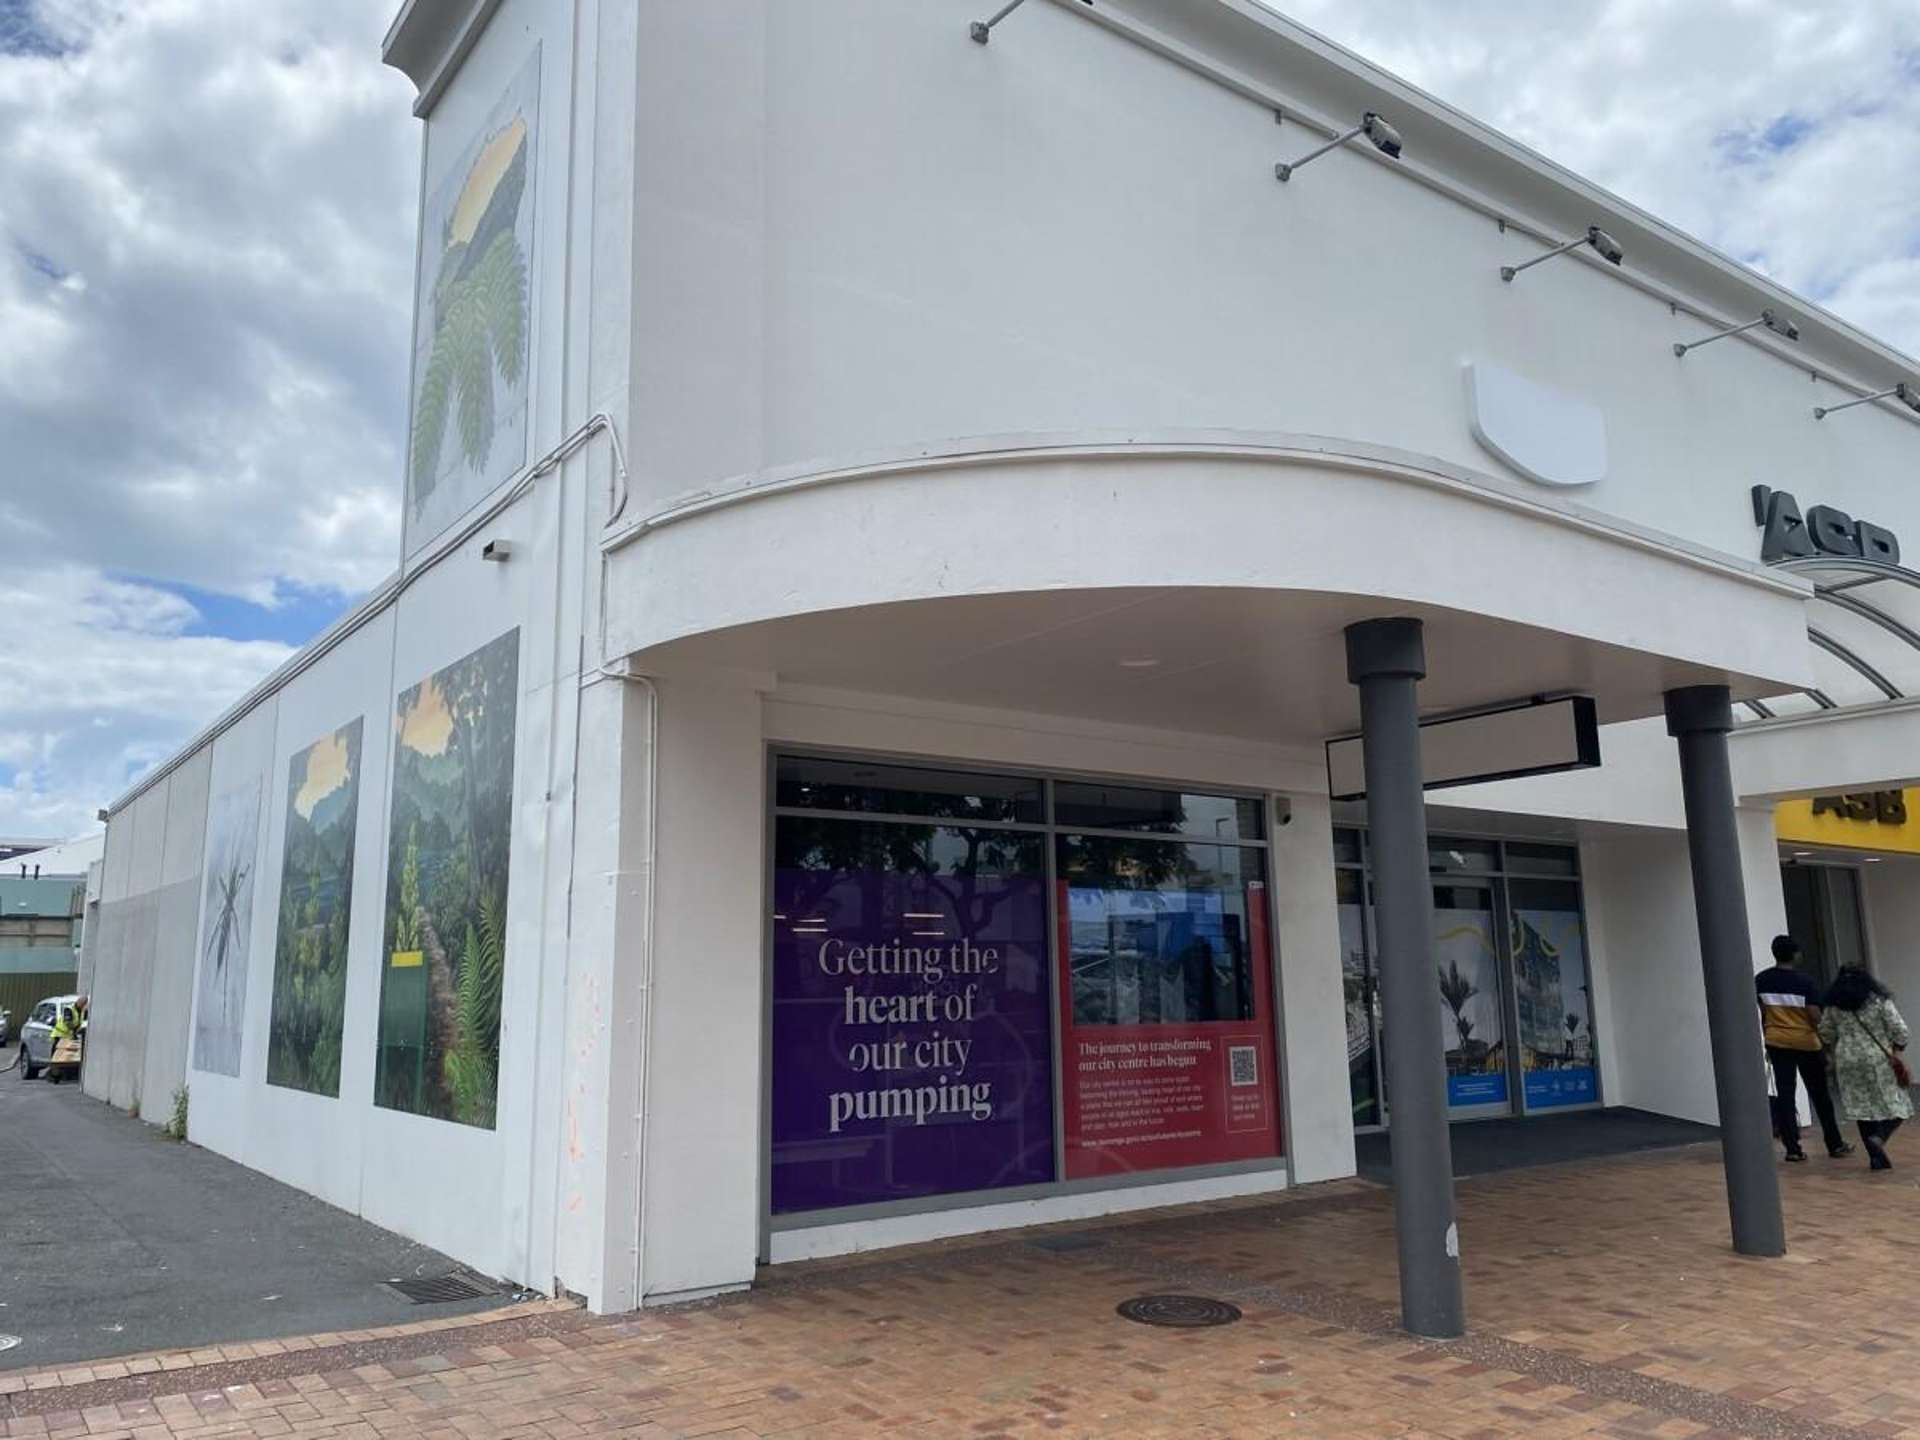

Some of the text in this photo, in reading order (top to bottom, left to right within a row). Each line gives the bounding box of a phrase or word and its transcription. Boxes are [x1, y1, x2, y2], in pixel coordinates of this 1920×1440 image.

[818, 937, 999, 985] Getting the
[844, 983, 977, 1025] heart of
[849, 1030, 973, 1076] our city
[1078, 1036, 1212, 1056] The journey to transforming
[1078, 1060, 1097, 1071] our
[1098, 1057, 1115, 1071] city
[1117, 1057, 1148, 1068] centre
[1149, 1056, 1166, 1067] has
[828, 1074, 993, 1132] pumping
